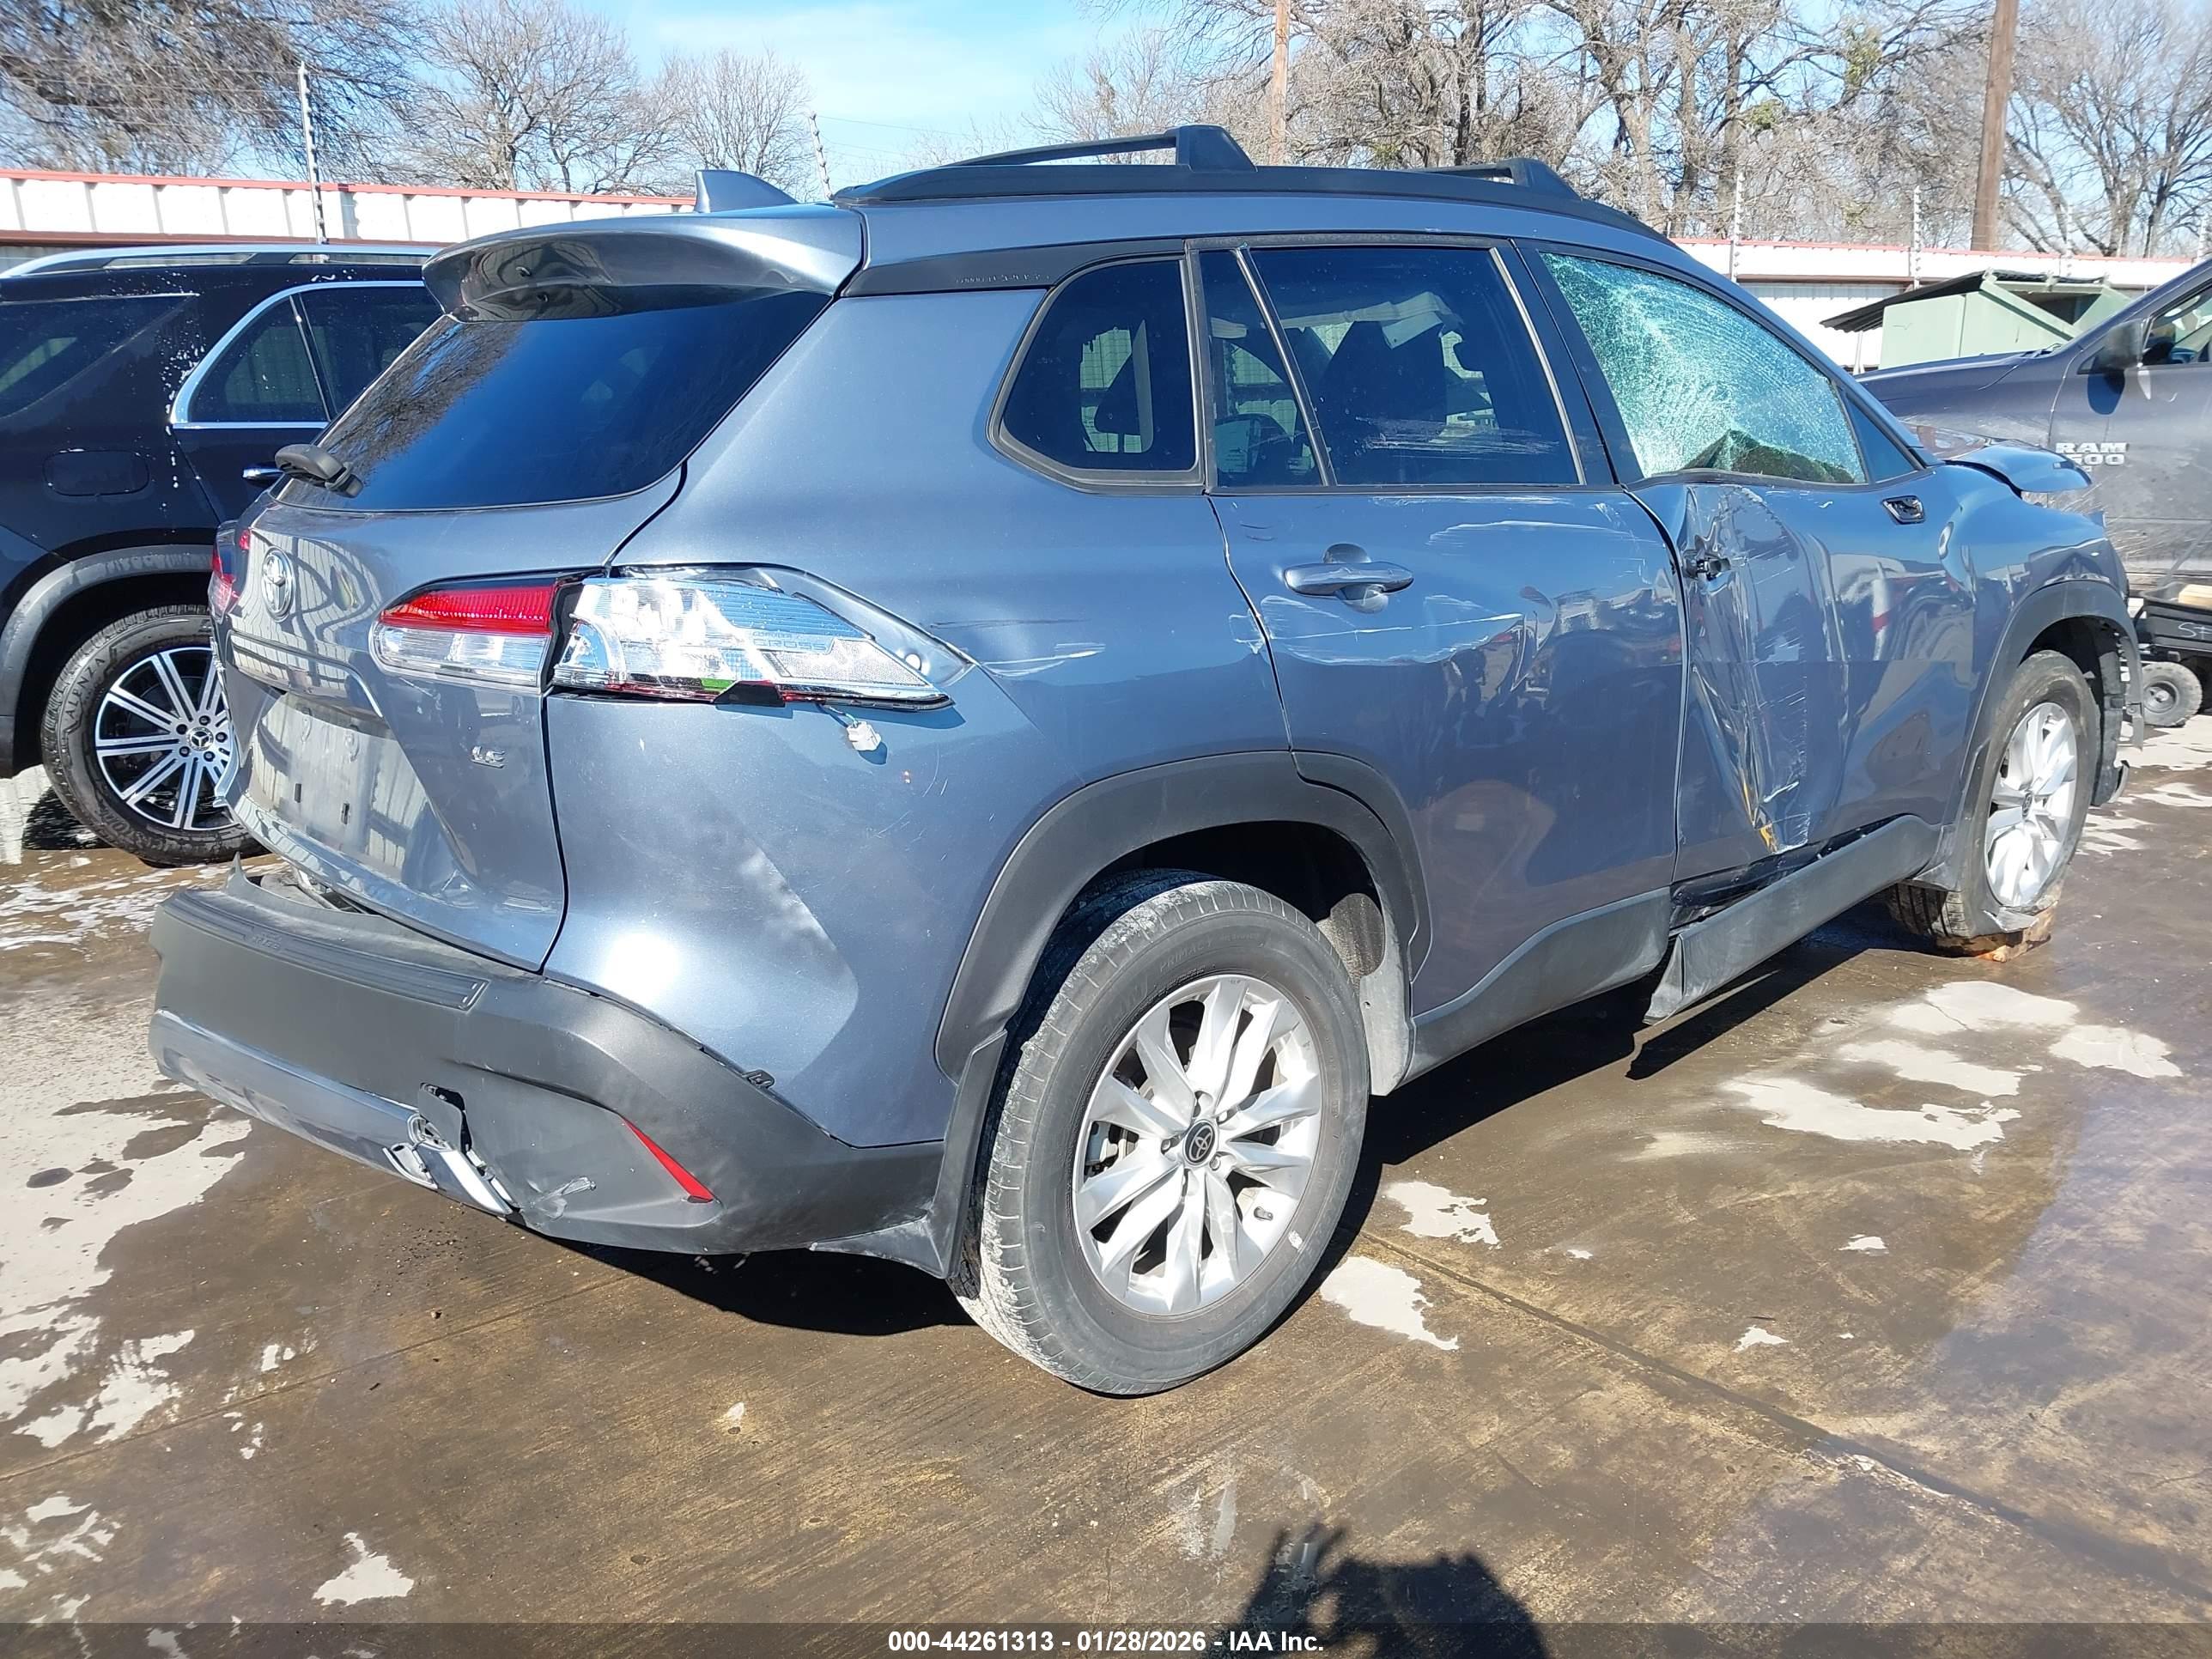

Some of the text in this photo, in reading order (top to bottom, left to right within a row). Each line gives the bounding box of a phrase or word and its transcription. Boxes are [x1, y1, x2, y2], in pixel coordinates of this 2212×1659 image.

[2055, 442, 2128, 453] RAM
[753, 638, 828, 651] CROSS
[65, 658, 105, 720] ALENZA
[471, 745, 507, 769] LE
[1159, 938, 1213, 973] PRIMACY
